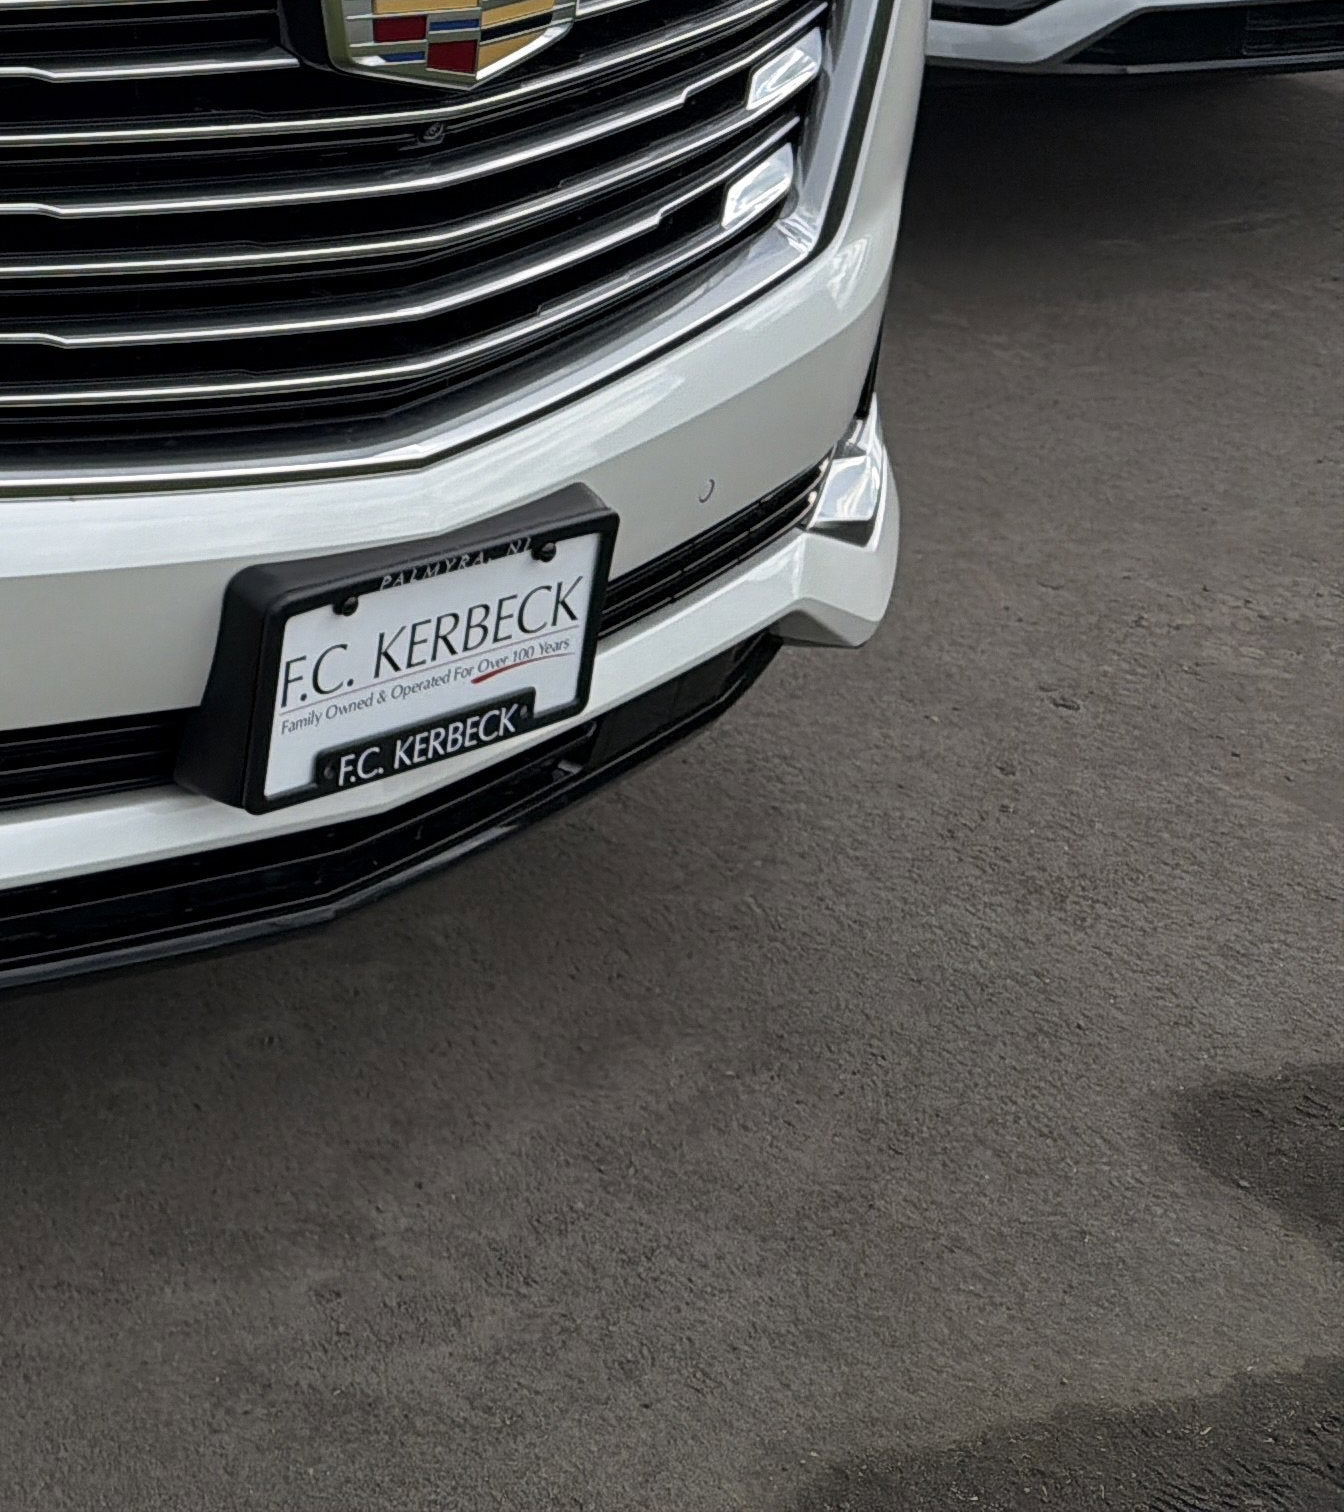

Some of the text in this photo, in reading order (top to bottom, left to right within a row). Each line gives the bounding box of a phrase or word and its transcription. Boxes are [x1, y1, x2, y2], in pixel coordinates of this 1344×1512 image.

[280, 576, 583, 707] F.C. KERBECK
[281, 638, 570, 735] Family Owned & Operated For Over 100 Years
[338, 703, 518, 787] F.C. KERBECK
